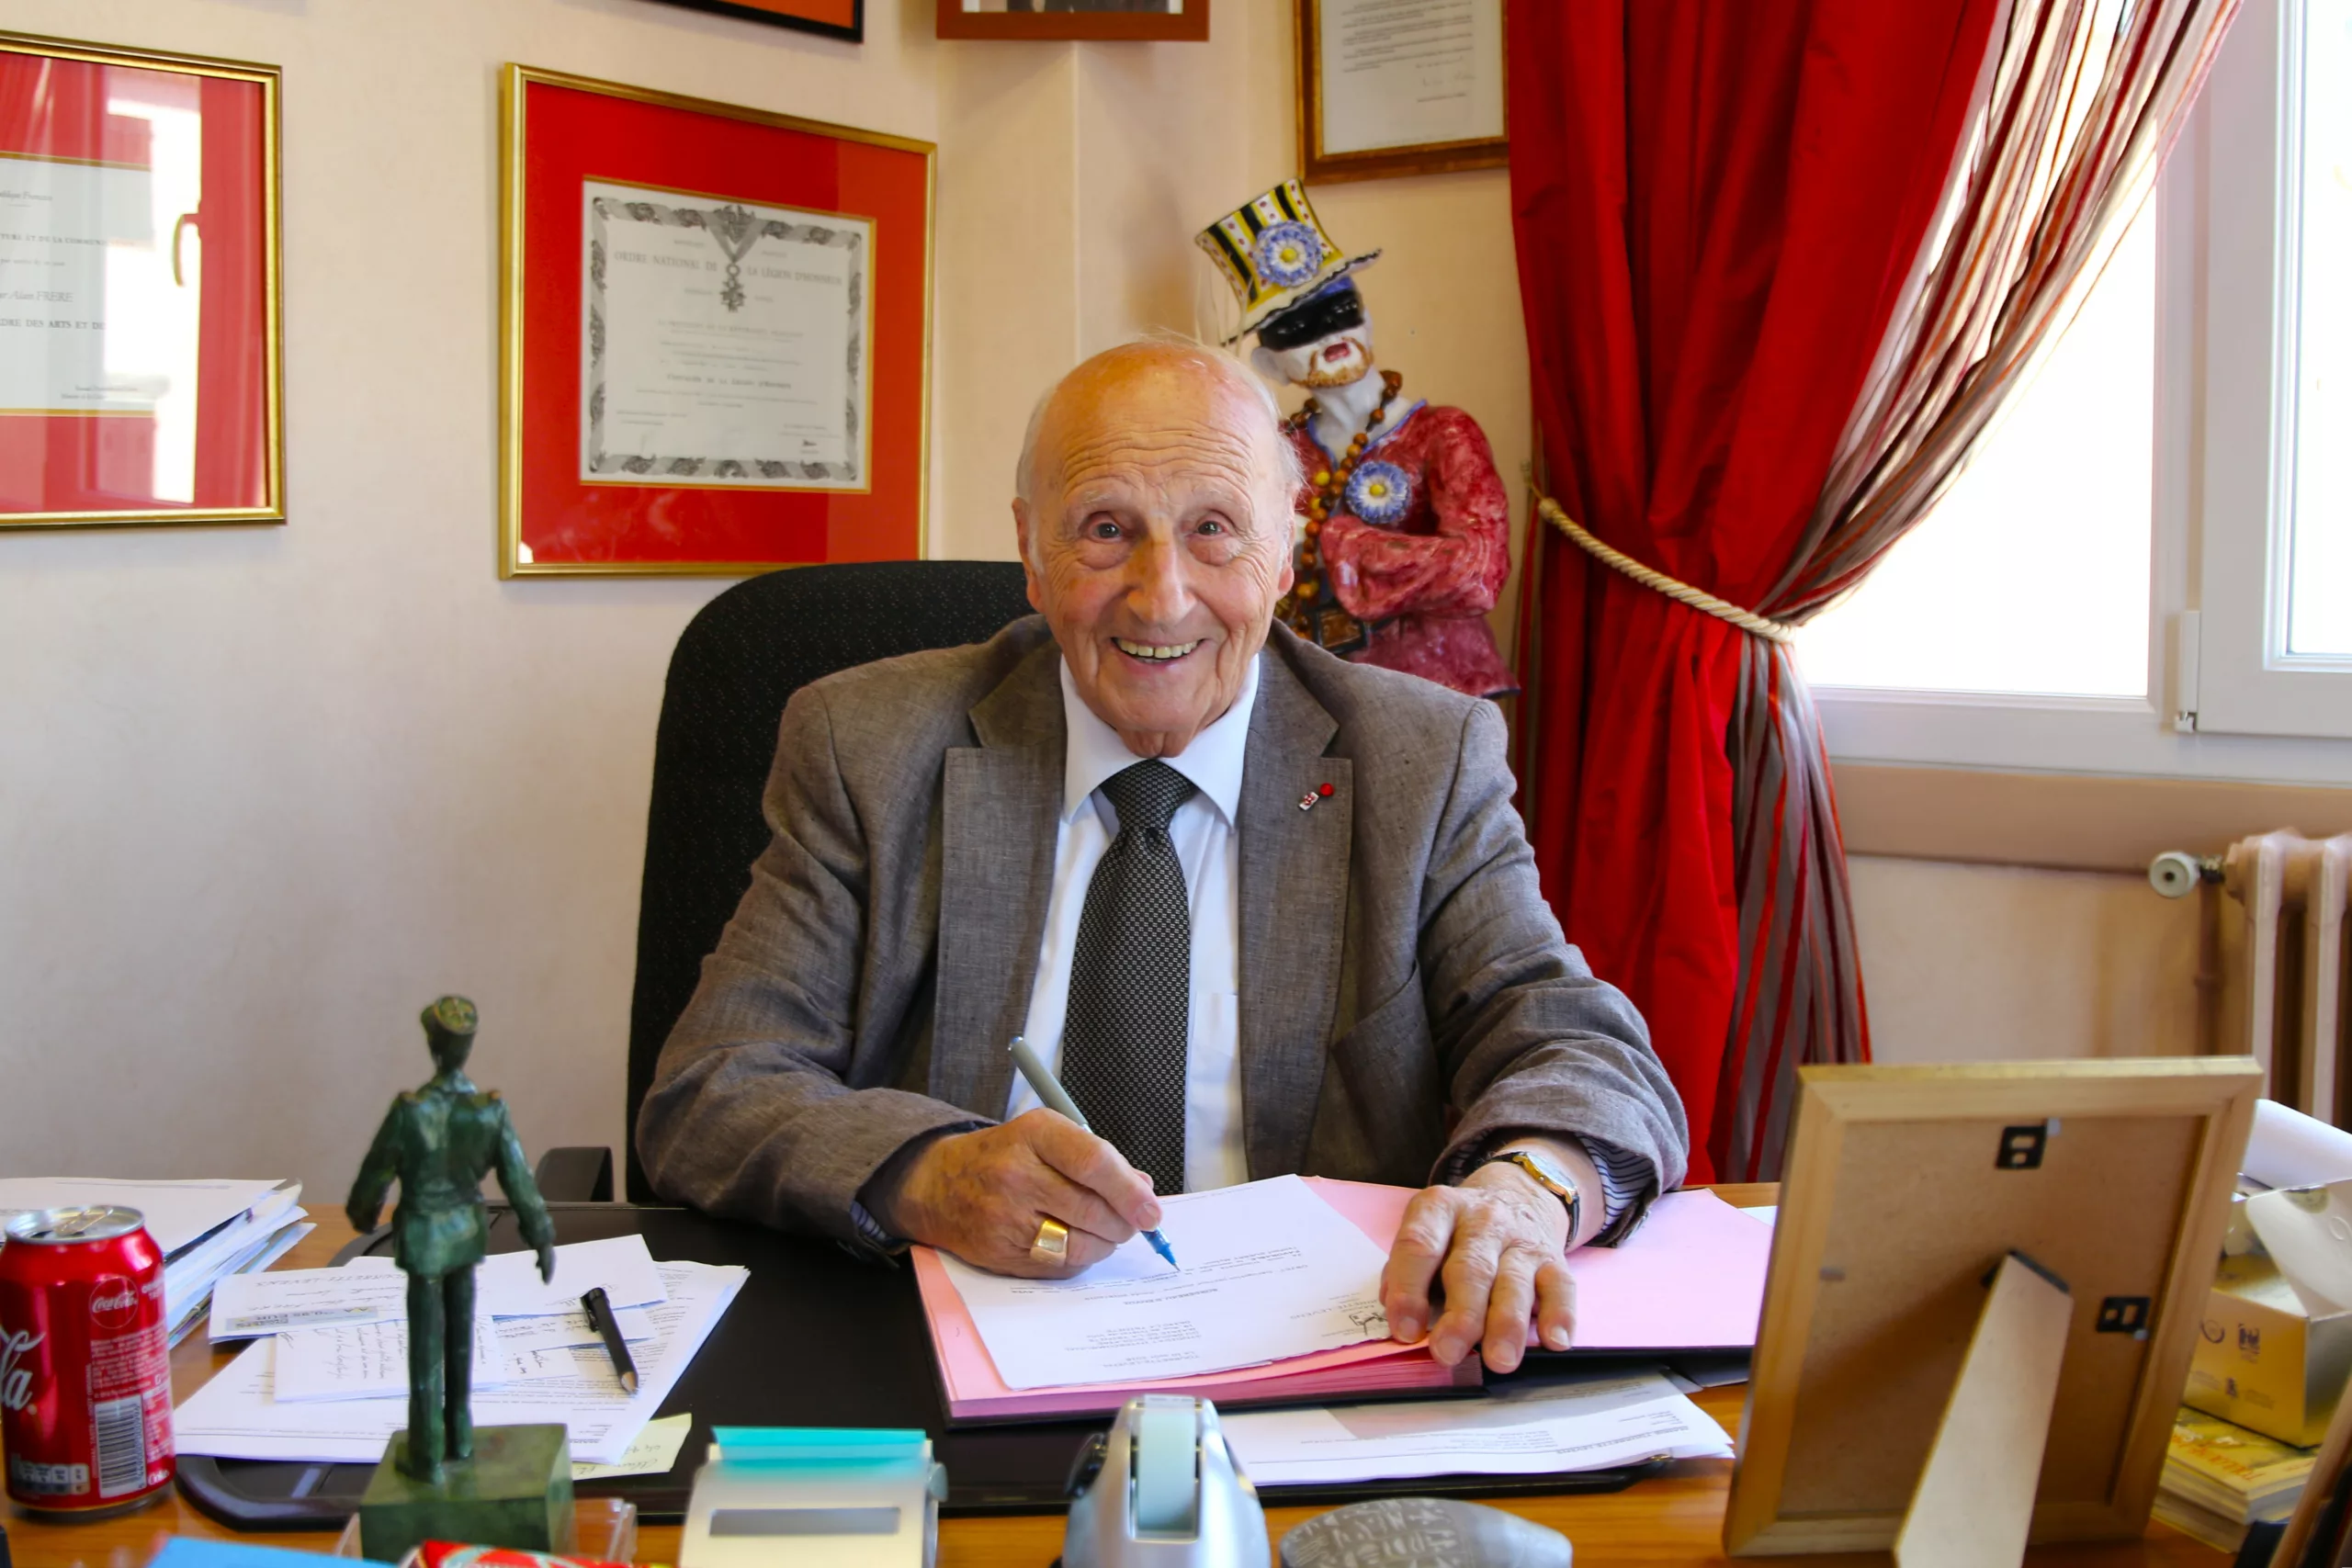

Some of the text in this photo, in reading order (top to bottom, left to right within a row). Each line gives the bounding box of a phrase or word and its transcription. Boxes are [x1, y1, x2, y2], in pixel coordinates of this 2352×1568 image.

[614, 251, 648, 264] ORDRE
[652, 254, 701, 271] NATIONAL
[49, 320, 72, 330] ARTS
